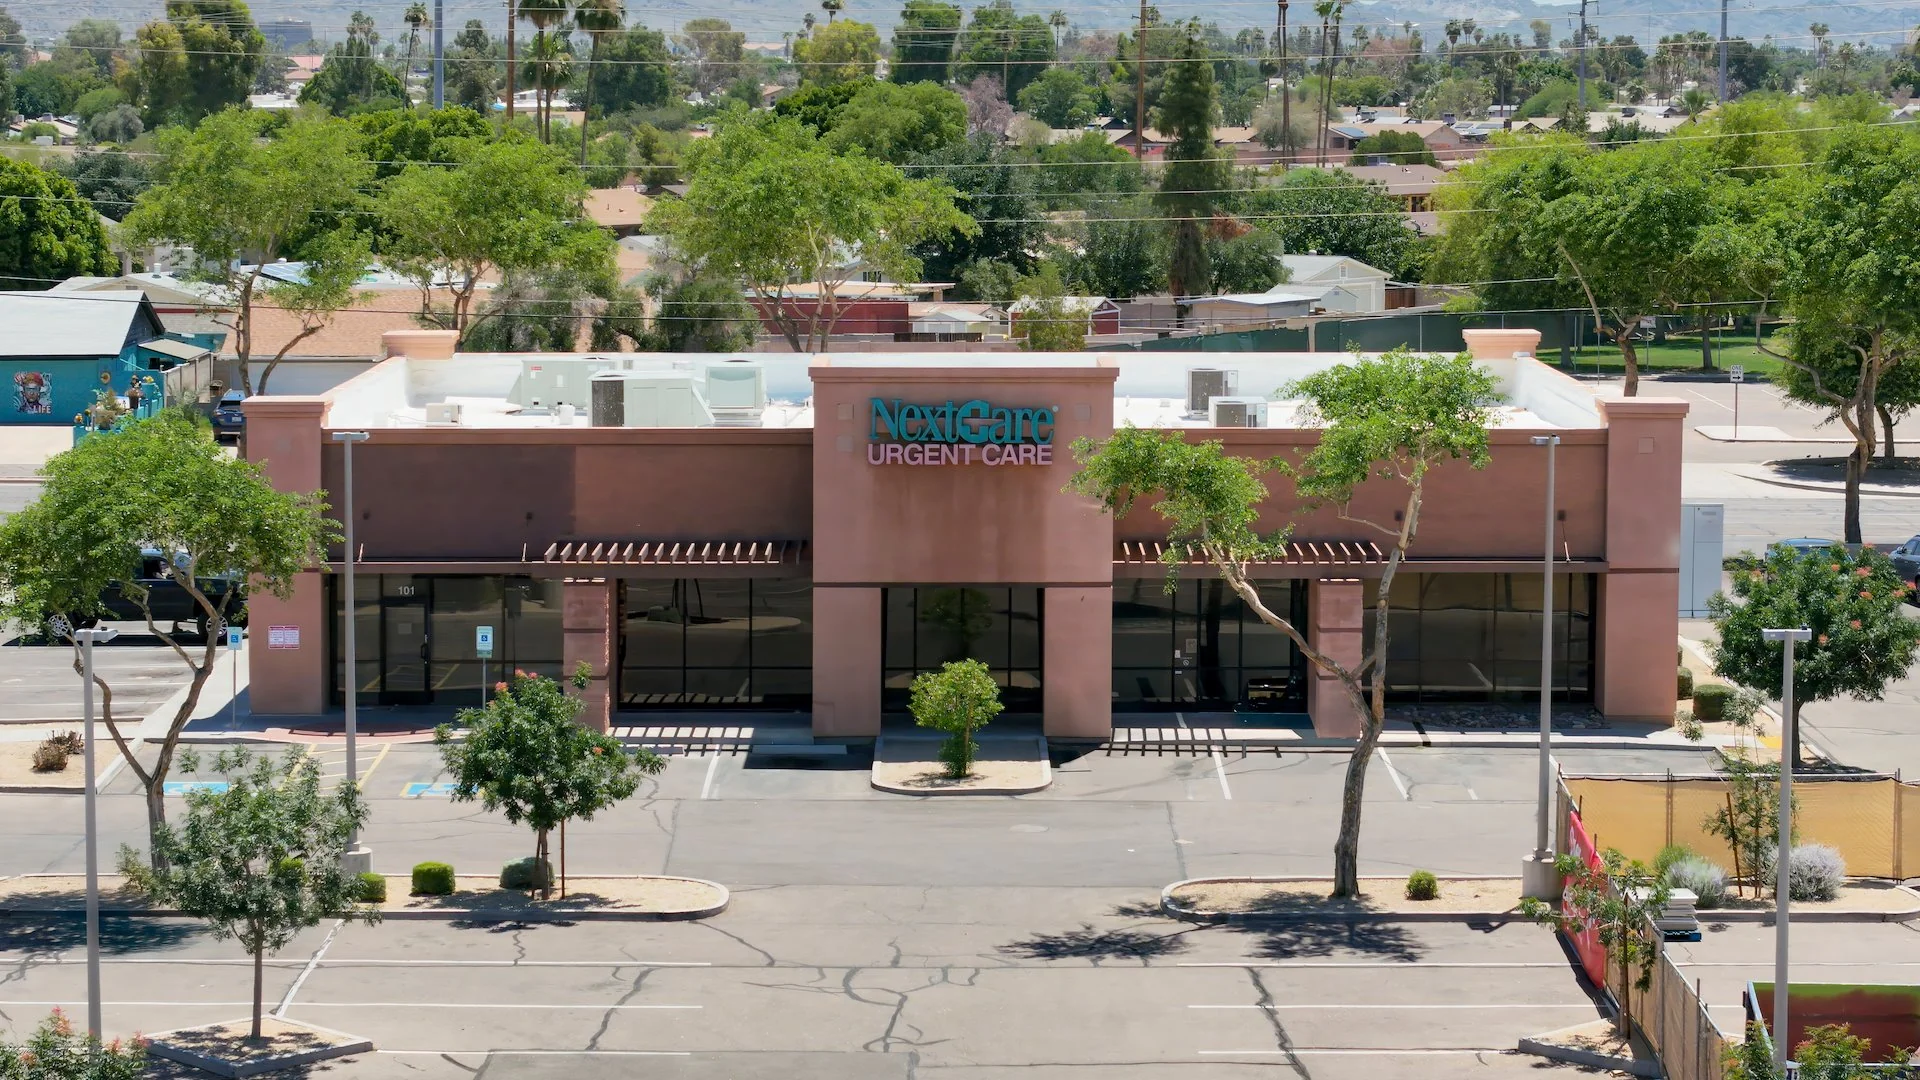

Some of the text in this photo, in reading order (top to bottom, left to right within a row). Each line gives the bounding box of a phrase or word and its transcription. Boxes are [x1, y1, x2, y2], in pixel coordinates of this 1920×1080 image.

[33, 405, 51, 414] LIFE
[869, 397, 1054, 444] NextCare
[867, 443, 1052, 465] URGENT CARE
[398, 586, 415, 595] 101
